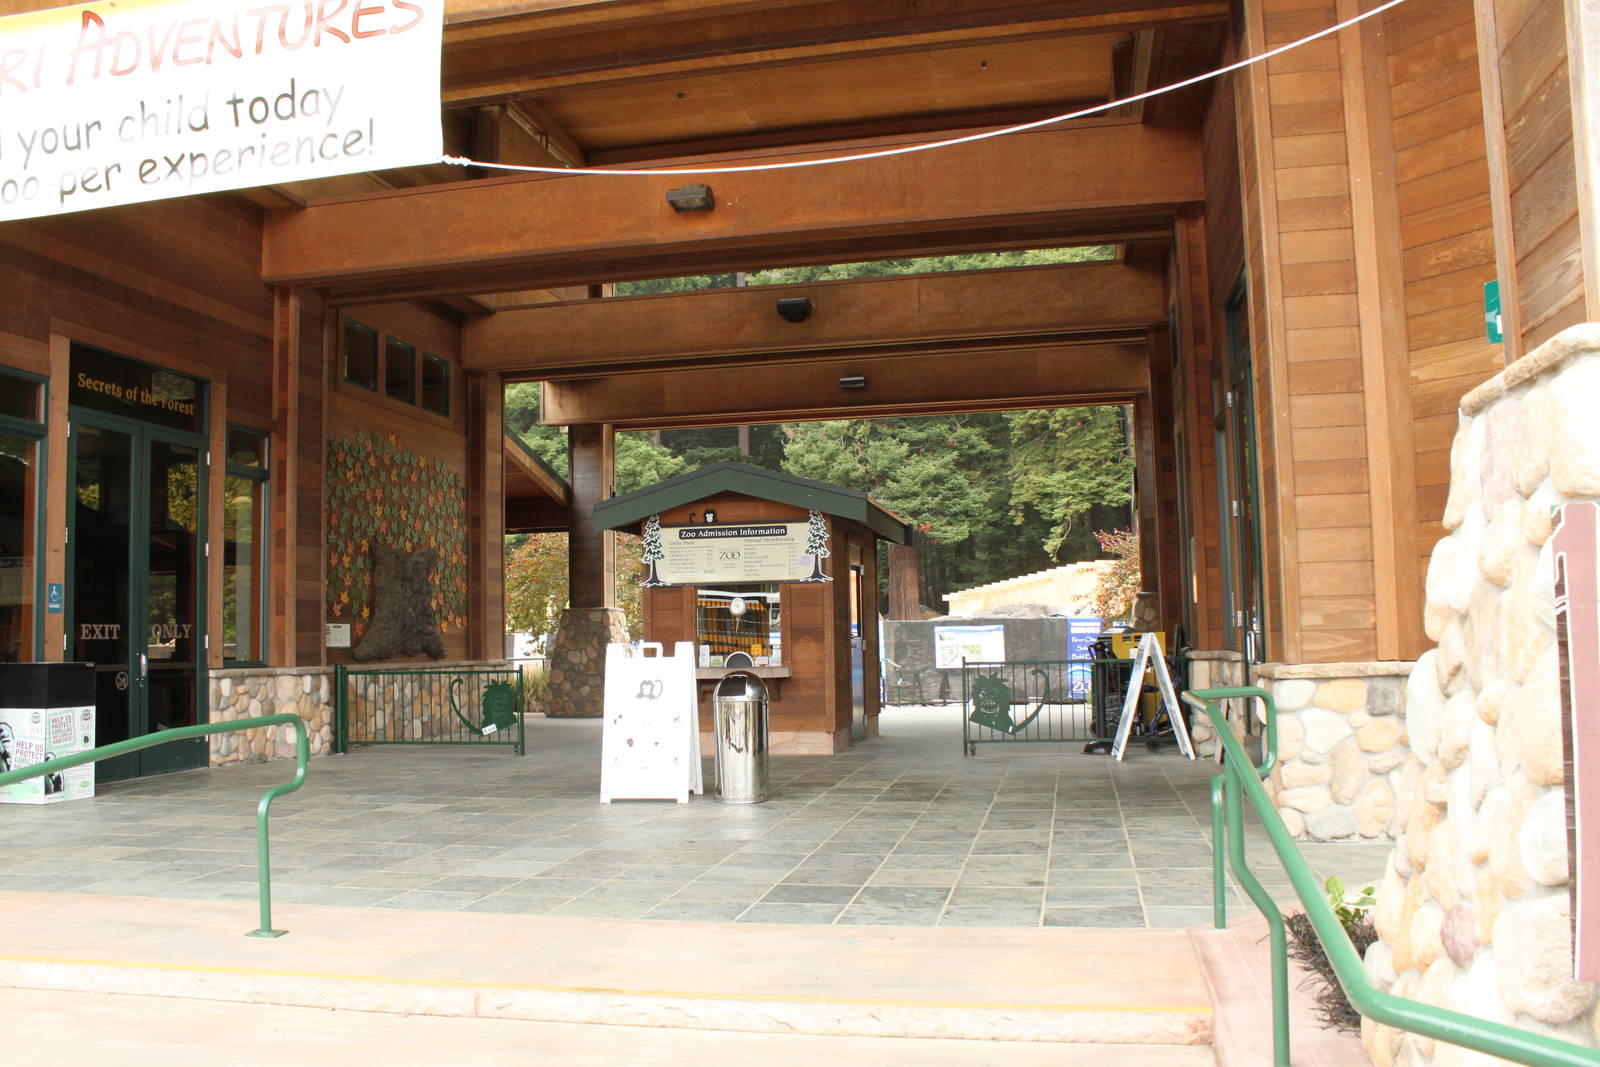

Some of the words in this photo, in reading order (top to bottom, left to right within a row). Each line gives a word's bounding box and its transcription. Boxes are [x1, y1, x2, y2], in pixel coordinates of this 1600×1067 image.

[17, 120, 102, 170] your
[118, 92, 209, 144] child
[226, 78, 345, 128] today
[138, 118, 376, 190] experience!
[78, 373, 122, 397] Secrets
[126, 386, 139, 400] of
[141, 388, 158, 406] the
[160, 395, 195, 416] Forest
[698, 529, 737, 537] Admission
[740, 527, 785, 535] Information
[80, 623, 120, 641] EXIT
[151, 623, 192, 640] ONLY
[15, 748, 43, 760] PROTECT
[16, 739, 33, 750] HELP
[35, 743, 43, 752] US
